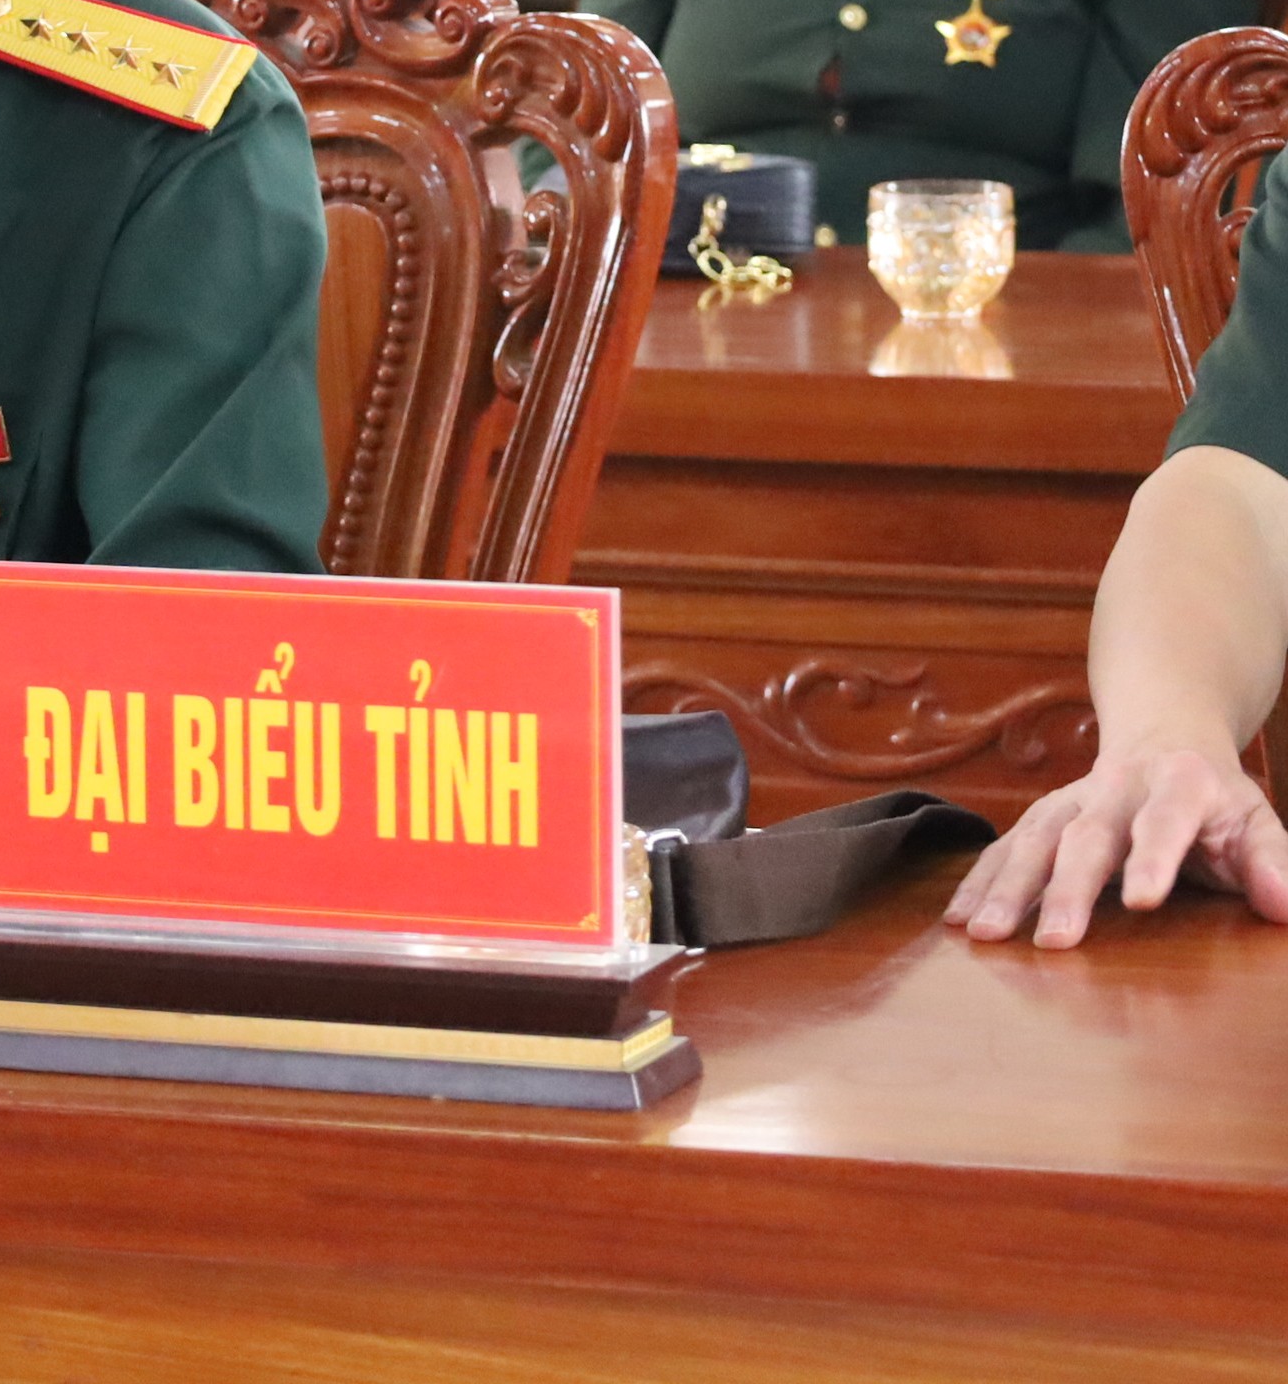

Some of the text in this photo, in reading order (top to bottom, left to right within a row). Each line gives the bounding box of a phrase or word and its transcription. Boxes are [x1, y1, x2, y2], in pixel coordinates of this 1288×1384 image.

[24, 642, 538, 853] ĐẠI BIỂU TỈNH
